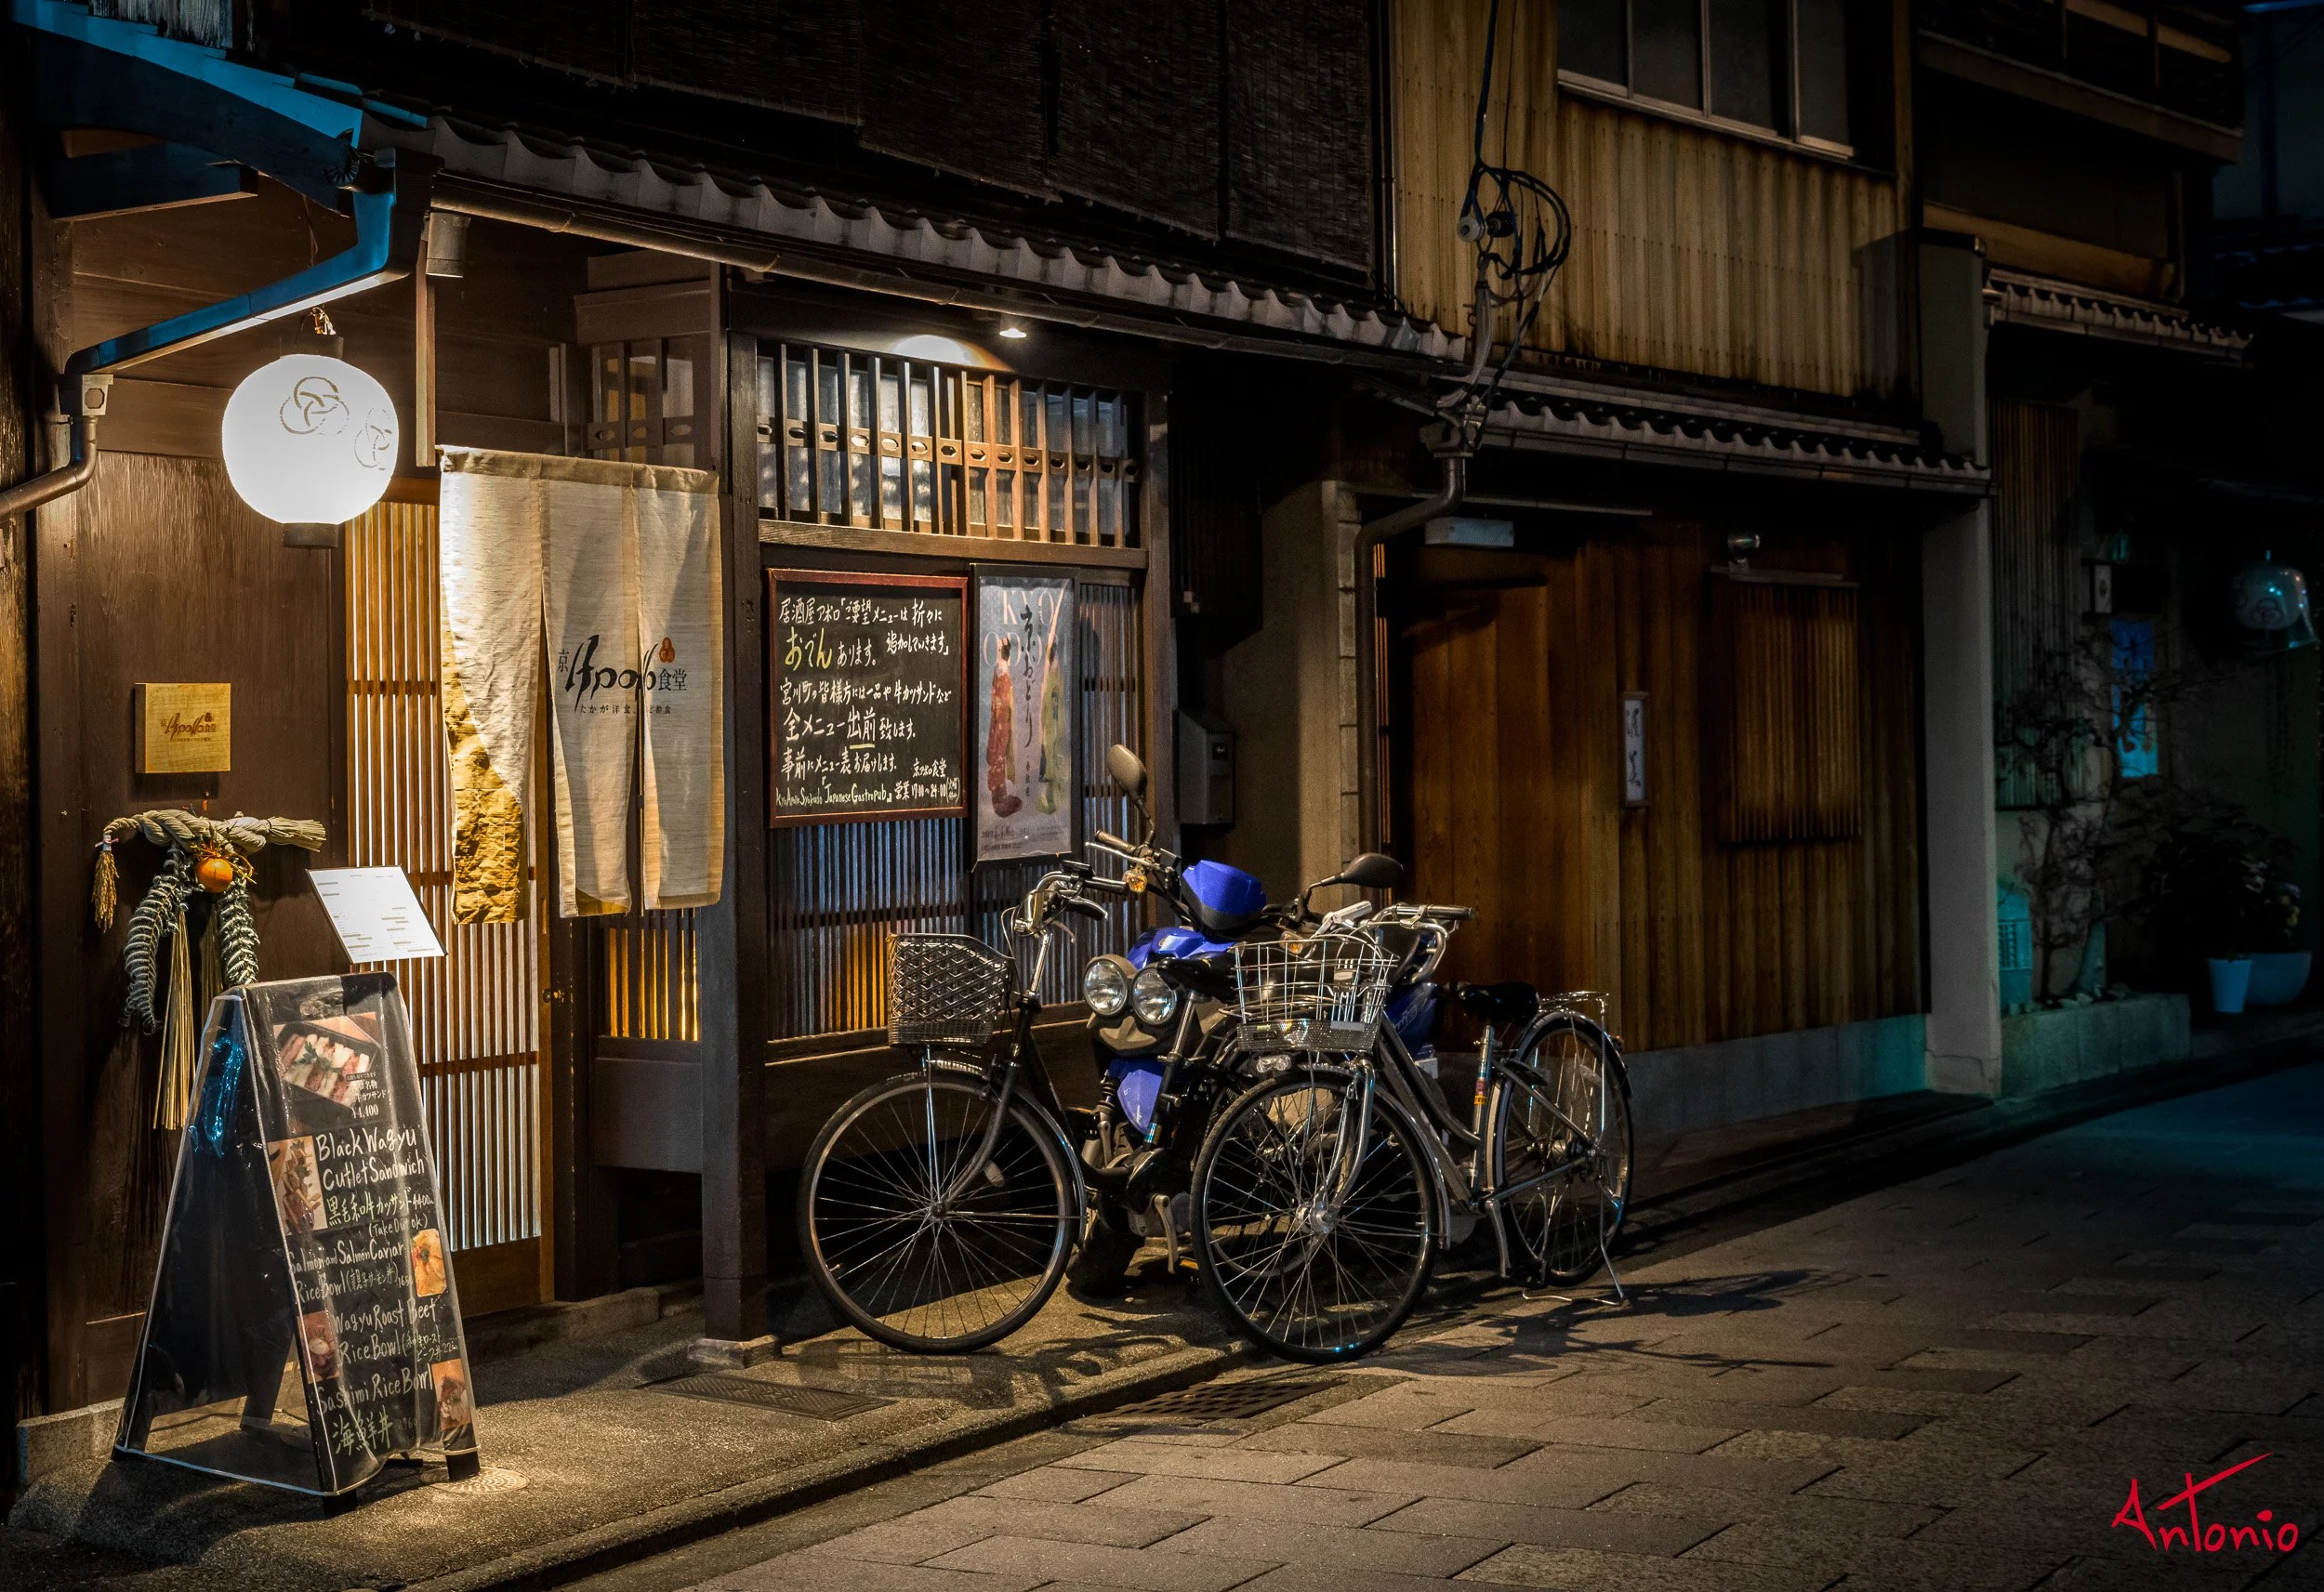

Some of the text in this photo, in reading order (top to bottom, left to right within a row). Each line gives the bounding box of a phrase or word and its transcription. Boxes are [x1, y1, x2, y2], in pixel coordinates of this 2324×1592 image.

[658, 668, 687, 691] 食堂
[316, 1126, 416, 1162] Black Wagyu
[323, 1148, 425, 1191] Cutlet Sandwich
[337, 1239, 370, 1264] Salmon
[369, 1237, 404, 1260] Caviar
[296, 1280, 321, 1303] Rice
[334, 1296, 437, 1334] Wagyu Roast Beef
[337, 1341, 371, 1364] Rice
[370, 1329, 402, 1360] Bowl
[372, 1373, 401, 1401] Rice
[401, 1362, 433, 1394] Bowl
[332, 1404, 393, 1456] 海鮮丼
